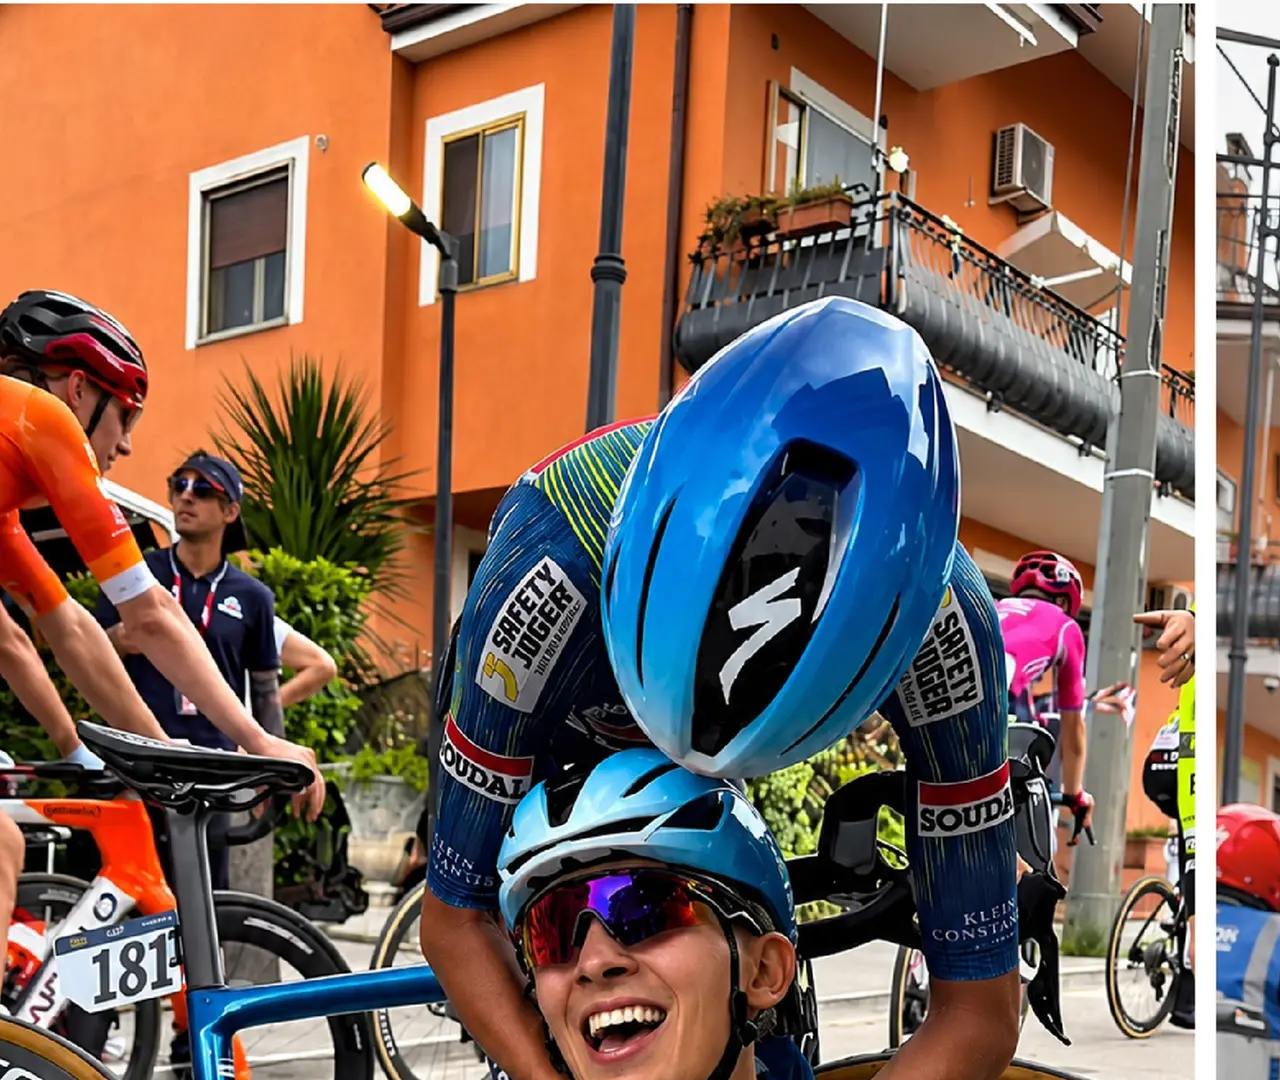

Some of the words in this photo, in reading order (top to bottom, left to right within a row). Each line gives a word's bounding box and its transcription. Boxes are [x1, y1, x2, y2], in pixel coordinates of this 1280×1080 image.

[491, 562, 557, 655] SAFETY
[934, 611, 979, 704] SAFETY
[92, 932, 175, 1006] 181
